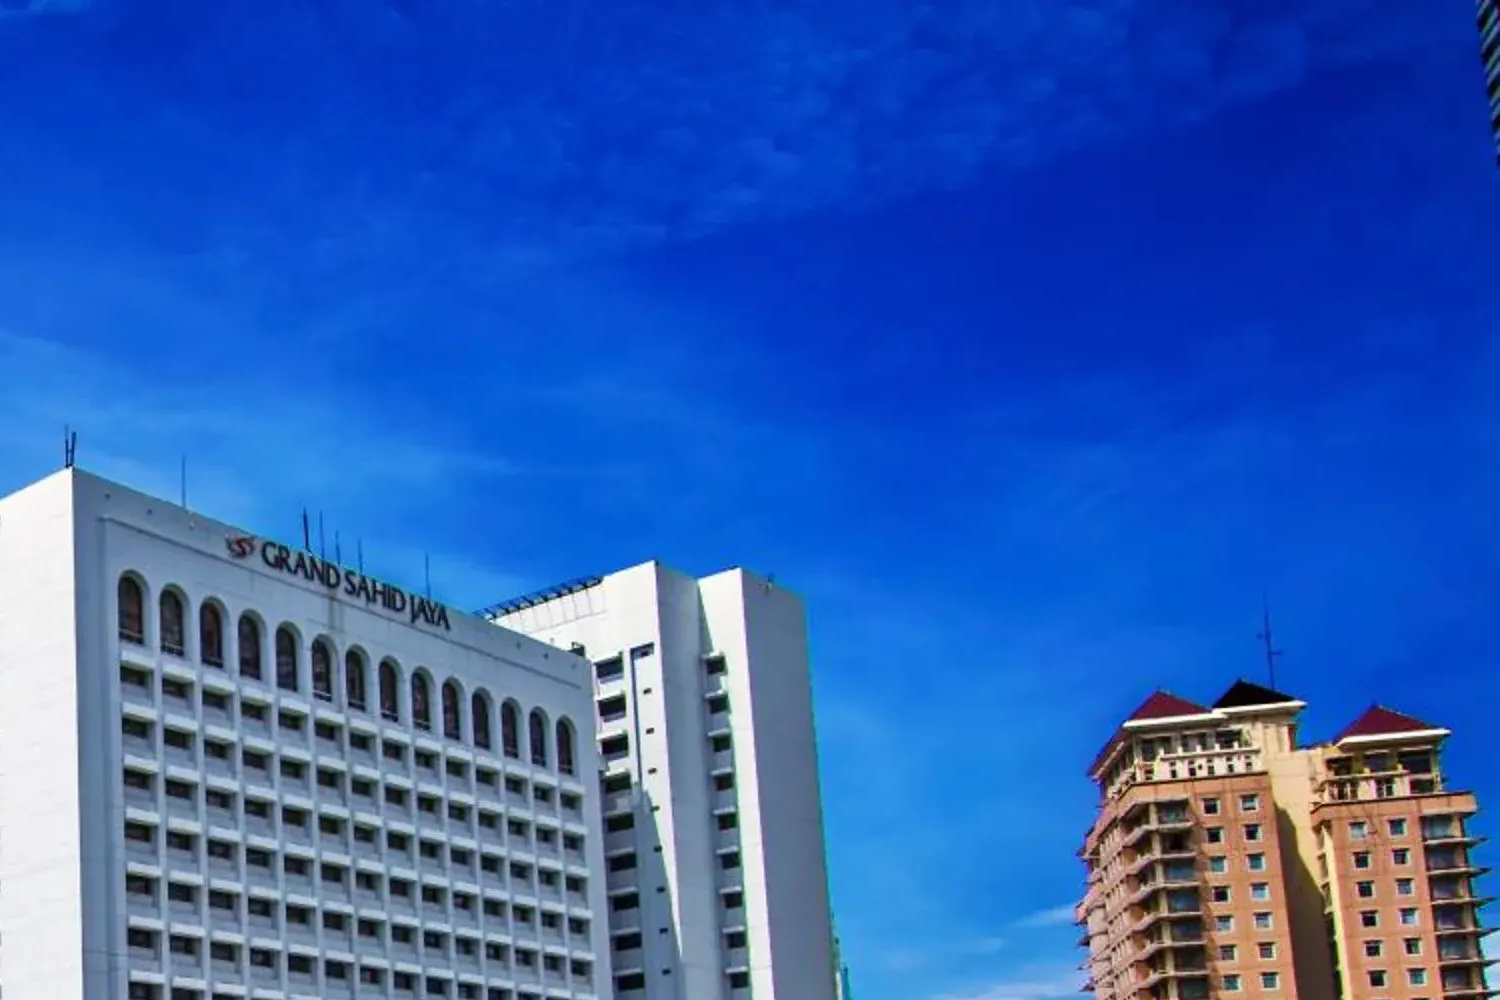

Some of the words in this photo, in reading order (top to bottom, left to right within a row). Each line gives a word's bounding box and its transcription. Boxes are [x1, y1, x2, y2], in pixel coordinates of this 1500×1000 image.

[261, 542, 341, 588] GRAND
[344, 571, 407, 612] SAHID
[411, 592, 451, 630] JAYA
